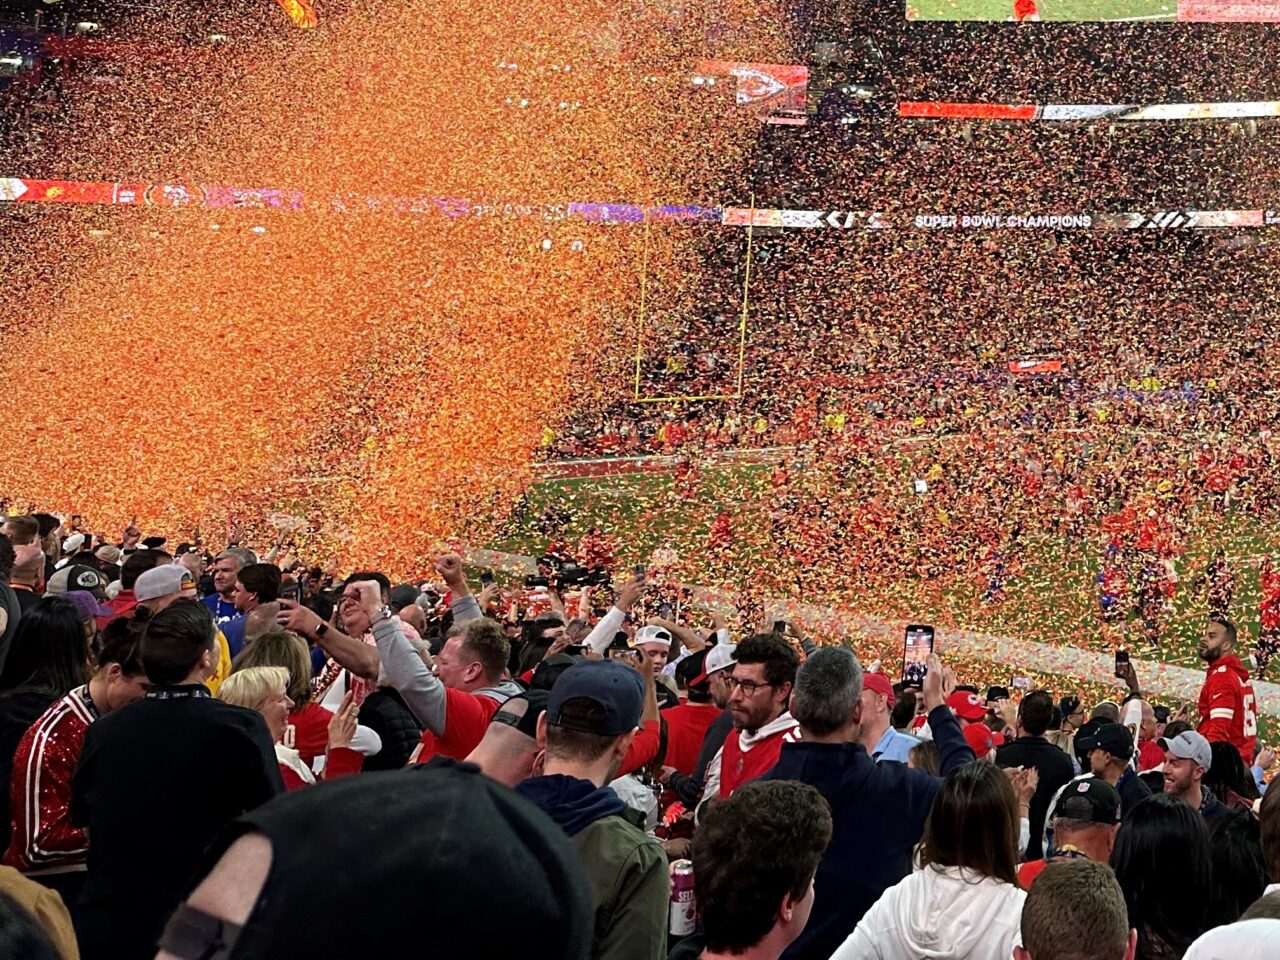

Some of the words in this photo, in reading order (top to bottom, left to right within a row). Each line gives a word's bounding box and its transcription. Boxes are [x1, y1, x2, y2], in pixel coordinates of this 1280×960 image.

[915, 215, 957, 229] SUPER
[962, 215, 1003, 228] BOWL
[1006, 214, 1092, 228] CHAMPIONS
